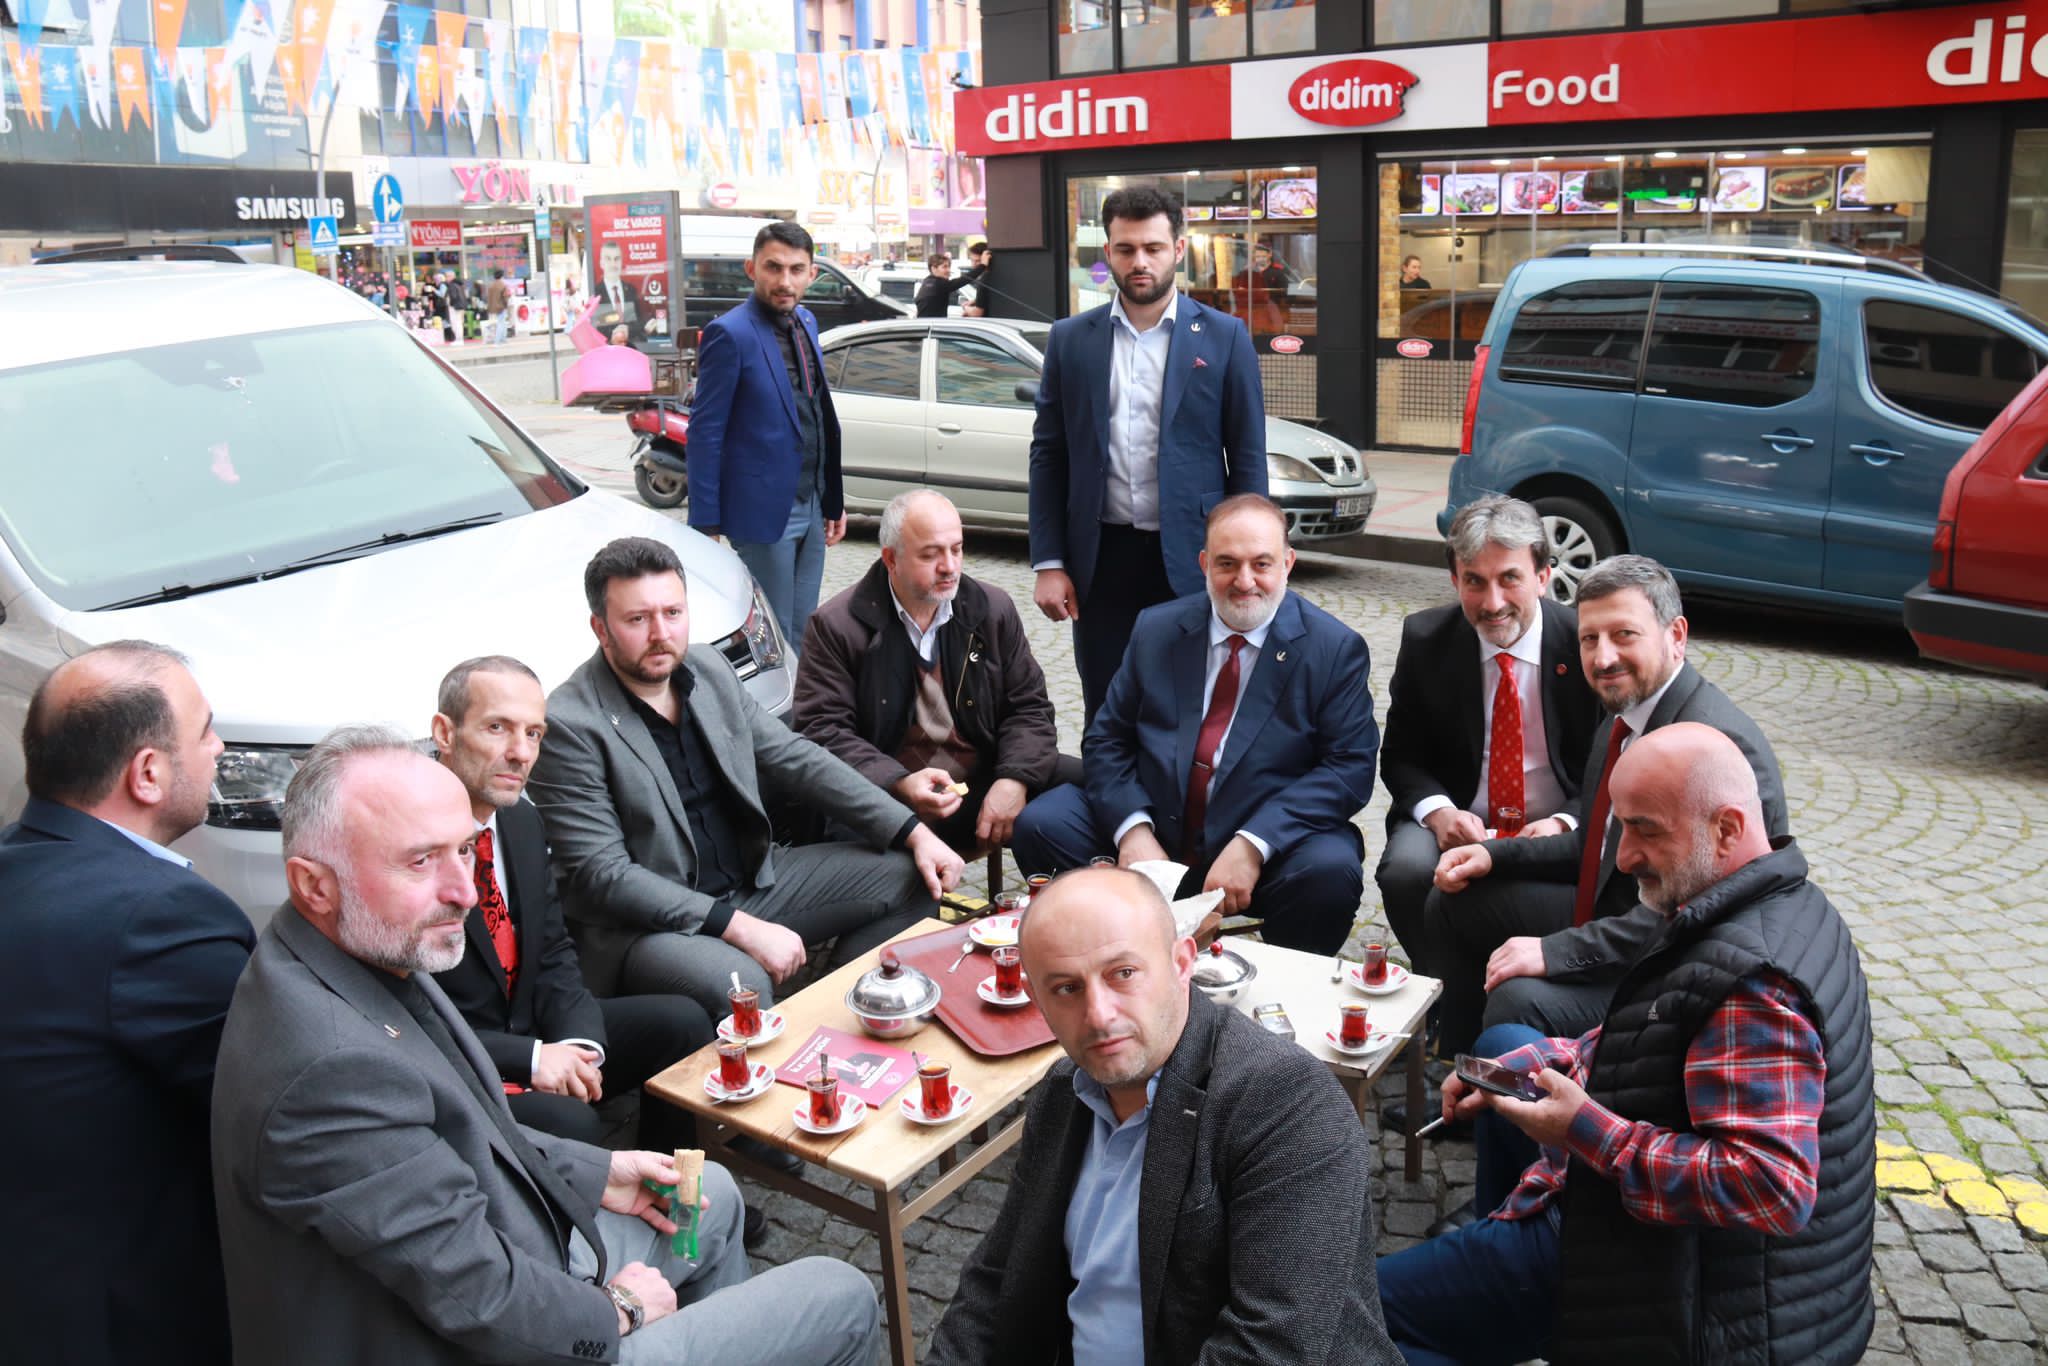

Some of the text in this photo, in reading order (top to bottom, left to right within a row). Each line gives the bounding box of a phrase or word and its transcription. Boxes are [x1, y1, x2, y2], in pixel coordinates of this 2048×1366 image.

[1925, 14, 2048, 87] di
[1299, 75, 1394, 111] didim
[1492, 63, 1620, 110] Food
[985, 87, 1149, 143] didim
[451, 160, 531, 203] YÖN
